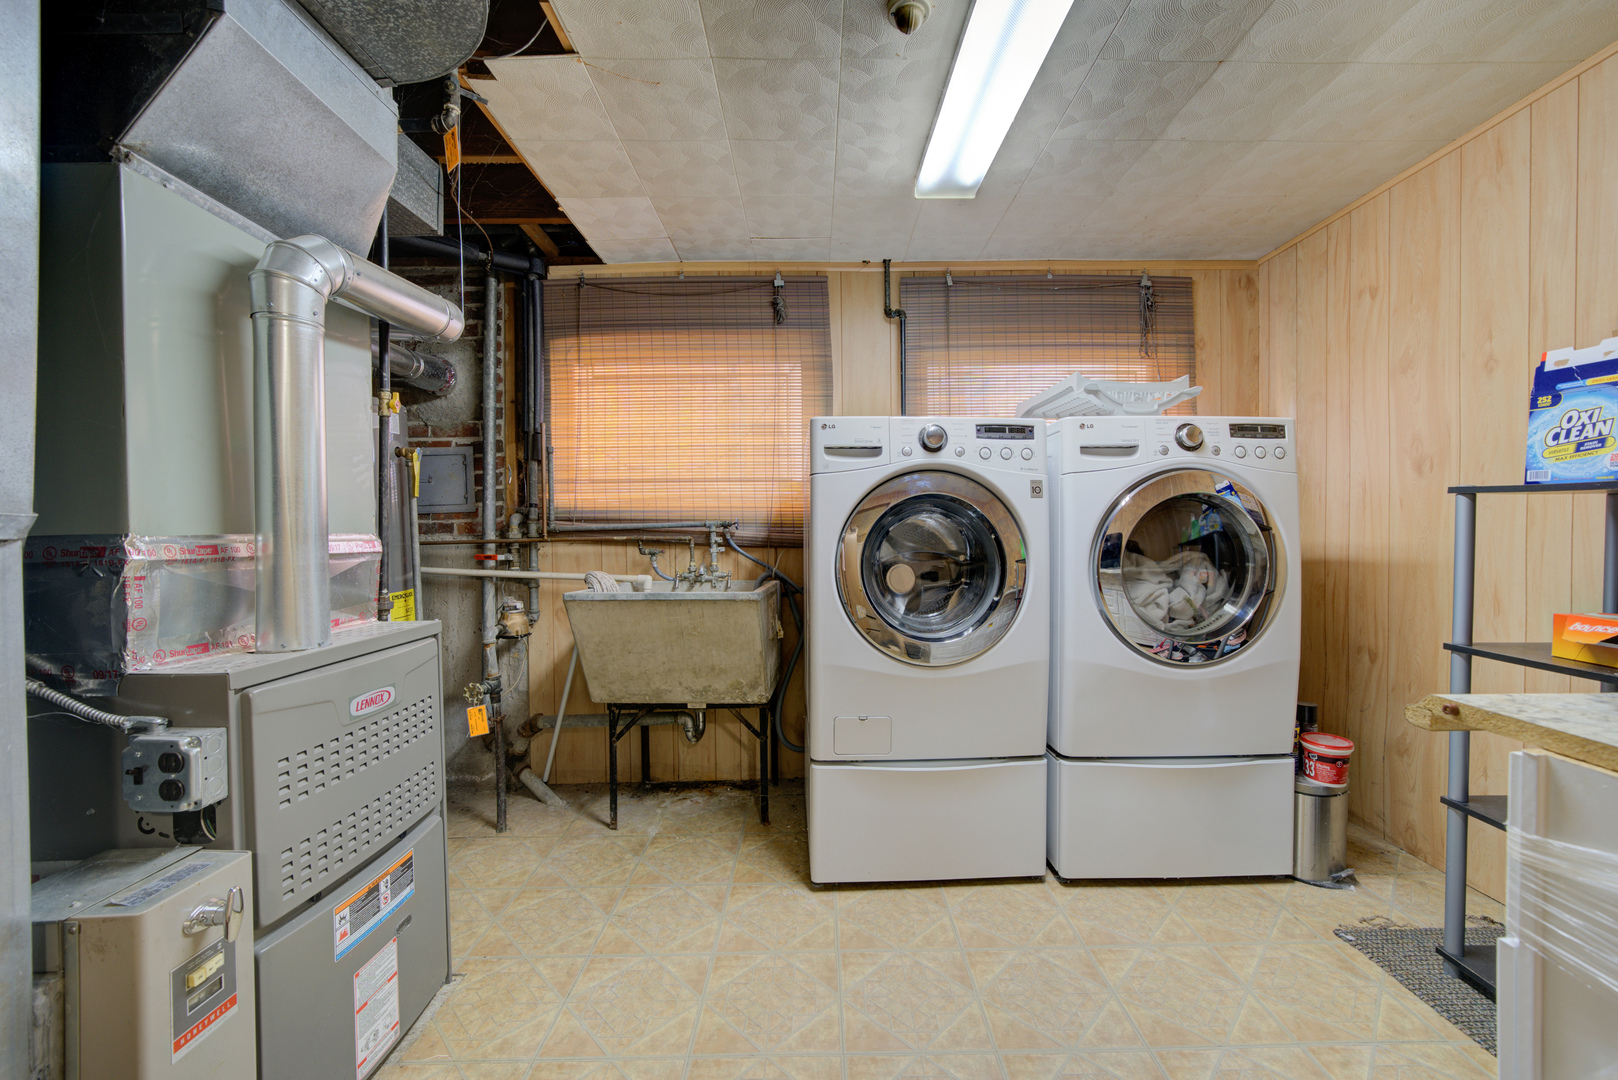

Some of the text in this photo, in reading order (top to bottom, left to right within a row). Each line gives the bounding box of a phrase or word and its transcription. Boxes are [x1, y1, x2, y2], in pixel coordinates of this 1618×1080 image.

[1537, 395, 1552, 404] 252
[1561, 408, 1602, 430] OXI
[1545, 418, 1615, 447] CLEAN
[1569, 450, 1599, 460] EFFICIENCY
[179, 545, 214, 556] Shurtape
[230, 546, 241, 554] 100
[133, 583, 144, 594] AF
[134, 595, 144, 610] 100
[169, 645, 204, 658] Shurtape
[92, 669, 118, 680] 09/17
[355, 693, 385, 712] LENNOX
[1304, 759, 1315, 777] 33
[180, 1001, 231, 1046] HONEYWELL
